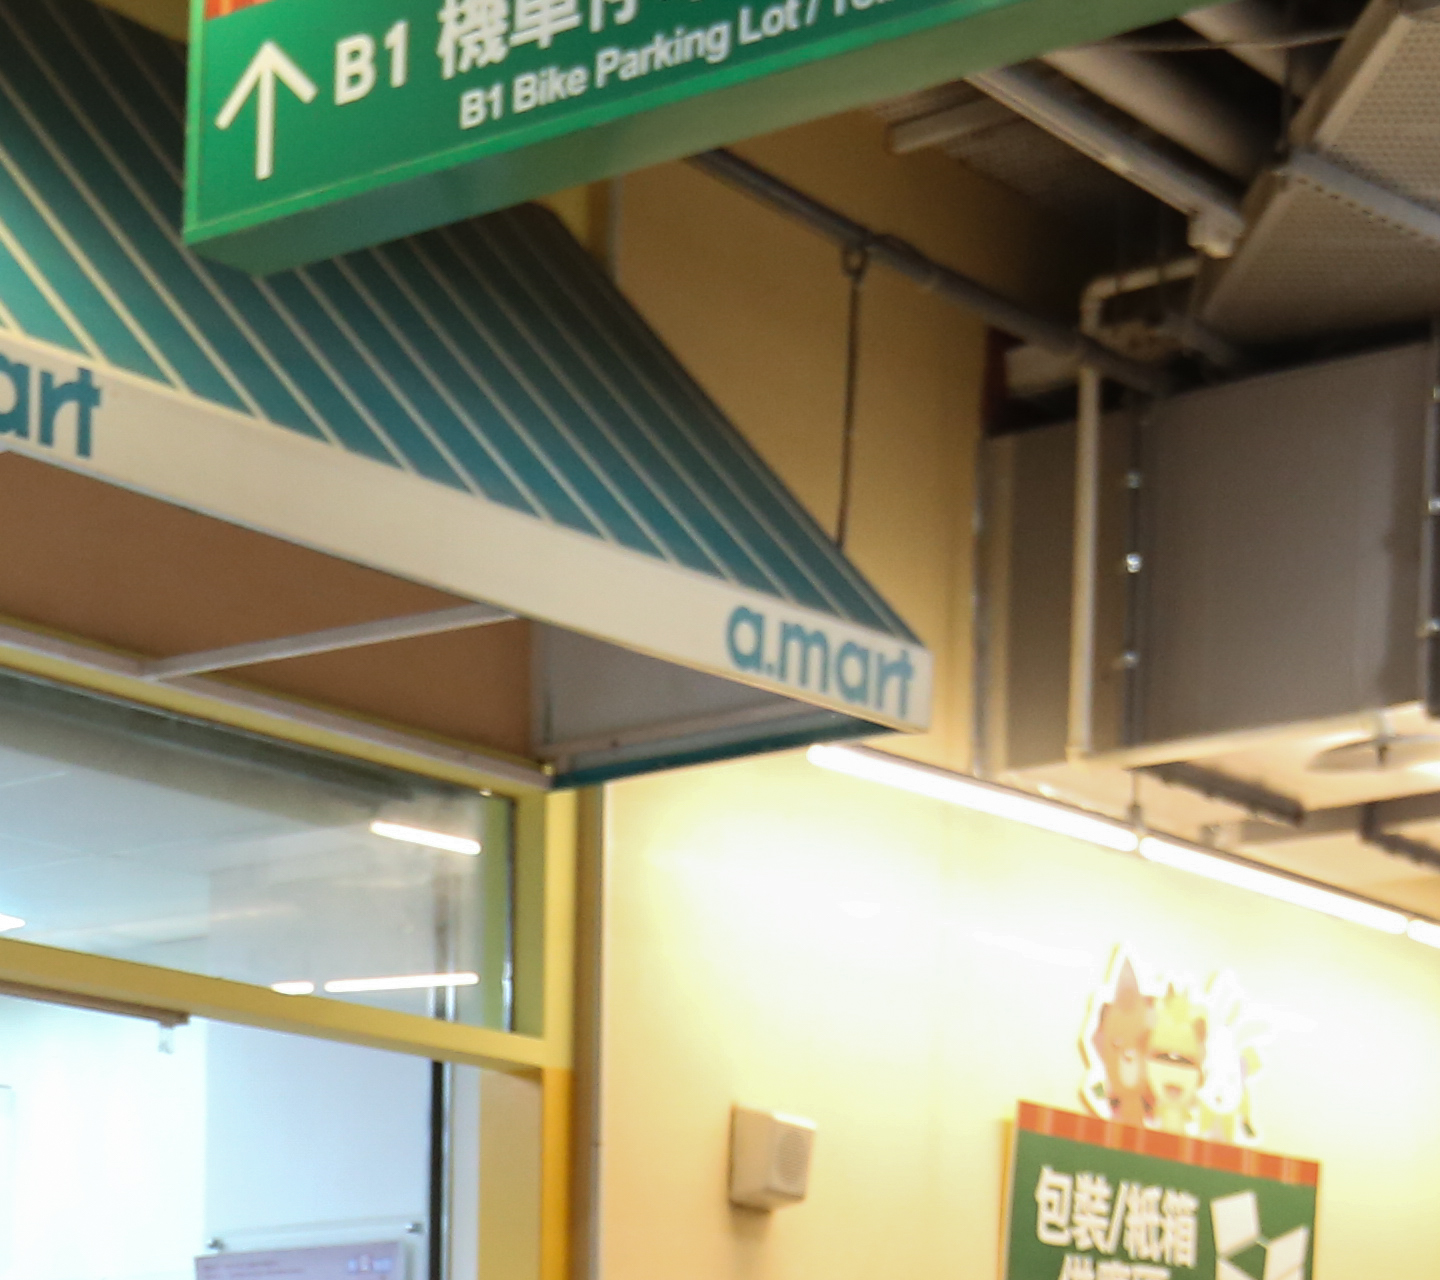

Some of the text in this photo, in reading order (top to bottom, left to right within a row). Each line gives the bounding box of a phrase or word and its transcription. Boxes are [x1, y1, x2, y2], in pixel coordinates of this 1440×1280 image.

[333, 22, 410, 106] B1
[459, 83, 505, 130] B1
[512, 64, 590, 114] Bike
[595, 20, 732, 88] Parking
[738, 5, 801, 45] Lot
[724, 605, 915, 720] a.mart
[1034, 1165, 1199, 1268] 包裝/紙箱
